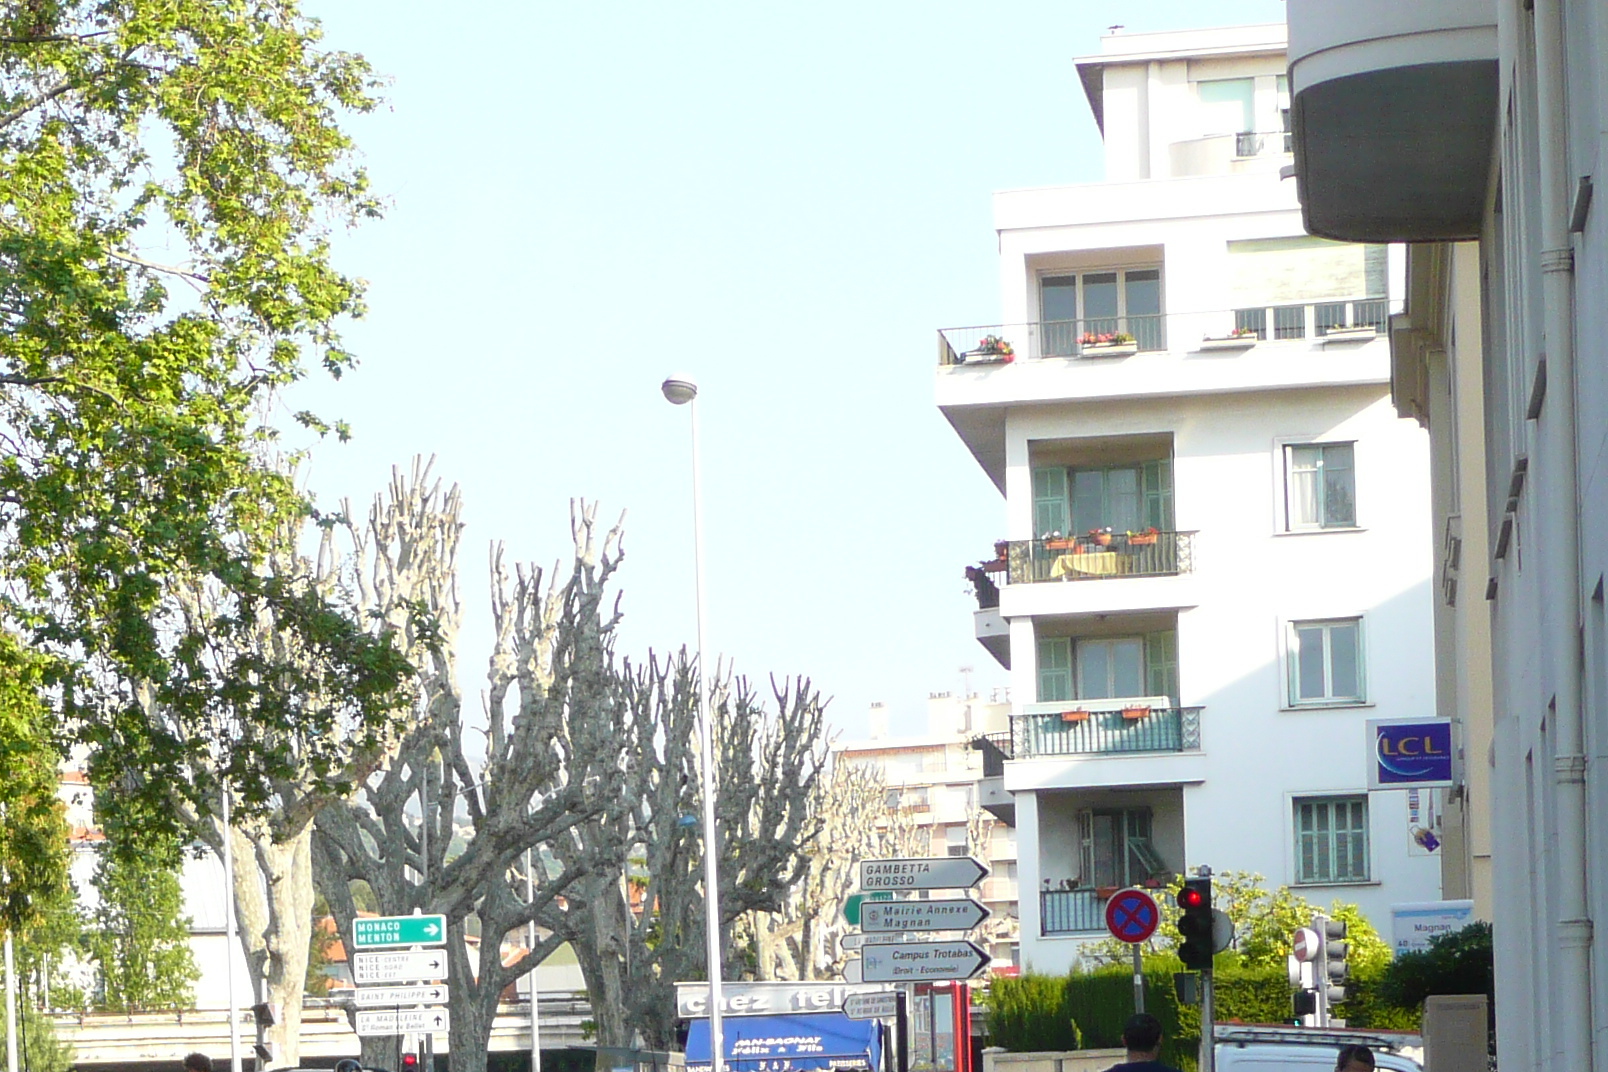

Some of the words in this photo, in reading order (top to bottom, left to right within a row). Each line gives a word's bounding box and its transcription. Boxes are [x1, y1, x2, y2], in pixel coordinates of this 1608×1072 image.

[1382, 736, 1443, 756] LCL
[866, 863, 930, 875] GAMBETTA
[866, 875, 915, 887] GROSSO
[883, 906, 923, 916] Mairie
[926, 904, 969, 915] Annexe
[357, 921, 400, 932] MONACO
[883, 917, 931, 929] Magnan
[1414, 923, 1451, 933] Magnan
[357, 932, 400, 943] MENTON
[892, 950, 930, 962] Campus
[933, 948, 974, 959] Trotabas
[360, 993, 385, 1001] SAINT
[389, 991, 426, 999] PHILIPPE
